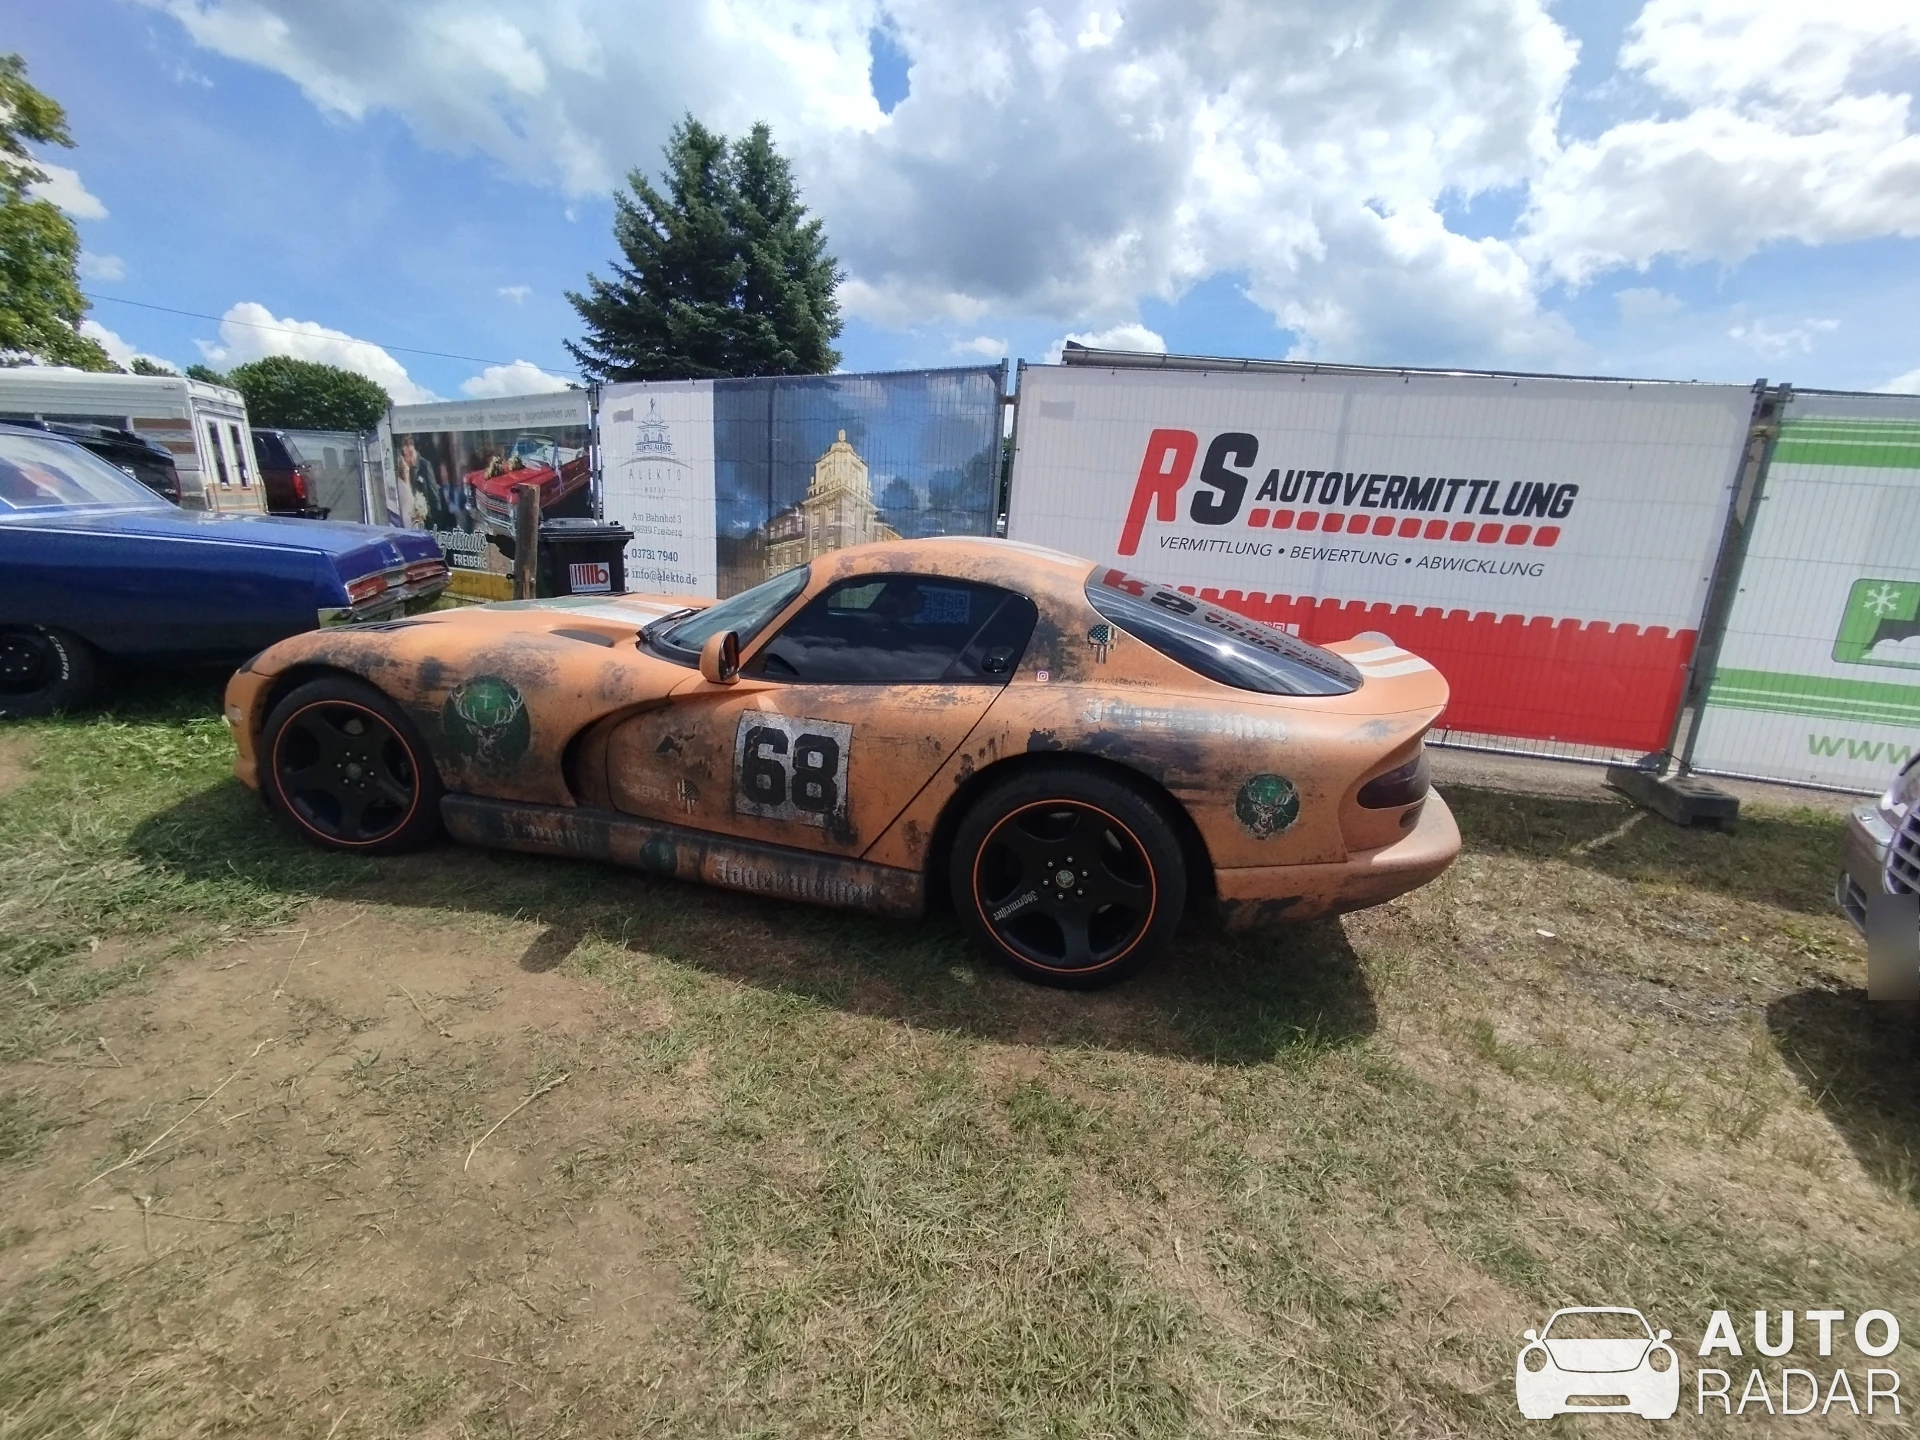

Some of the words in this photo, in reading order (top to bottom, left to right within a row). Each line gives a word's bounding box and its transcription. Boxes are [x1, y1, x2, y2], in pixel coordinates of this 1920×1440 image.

[628, 468, 682, 481] ALEKTO
[1117, 428, 1259, 557] RS
[1255, 468, 1580, 519] AUTOVERMITTLUNG
[631, 512, 645, 522] Am
[645, 512, 676, 524] Bahnhof
[676, 514, 682, 524] 3
[653, 525, 683, 539] Freiberg
[453, 553, 488, 569] FREIBERG
[631, 548, 656, 561] 03731
[657, 550, 679, 562] 7940
[1159, 534, 1272, 558] VERMITTLUNG
[1289, 545, 1399, 568] BEWERTUNG
[1416, 554, 1545, 578] ABWICKLUNG
[631, 567, 698, 586] info@alekto.de
[48, 635, 70, 681] COBRA
[742, 724, 841, 813] 68
